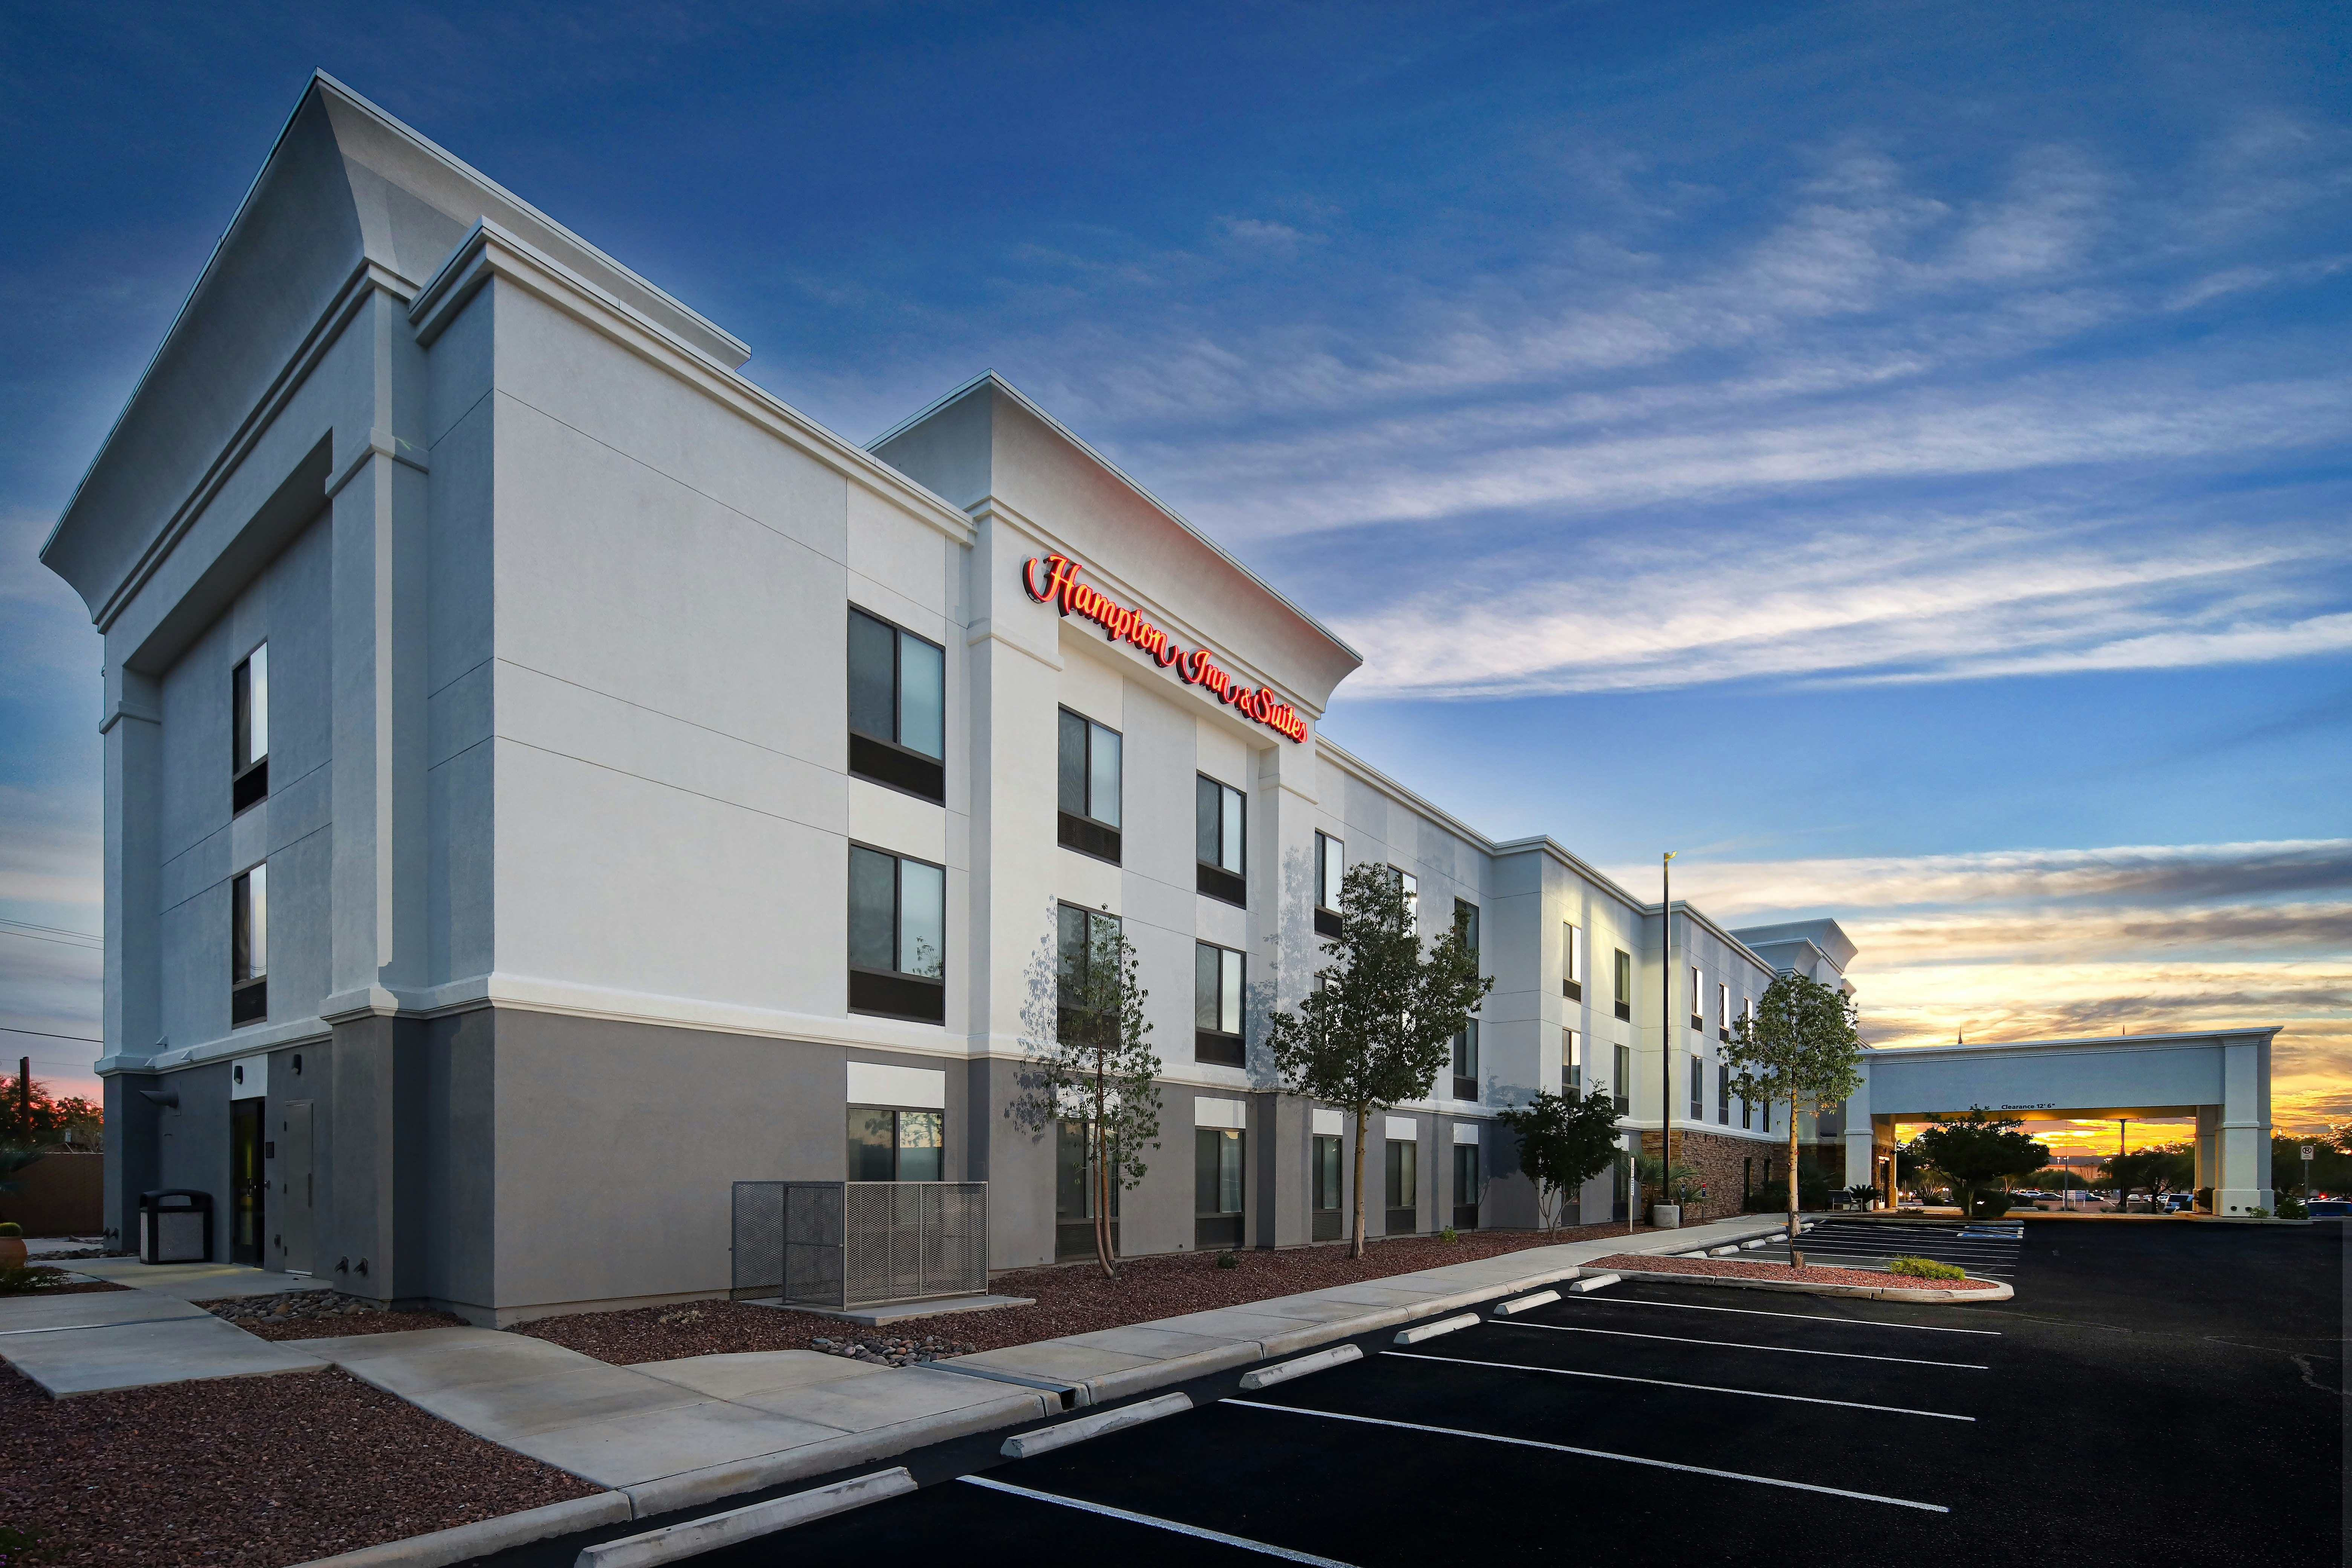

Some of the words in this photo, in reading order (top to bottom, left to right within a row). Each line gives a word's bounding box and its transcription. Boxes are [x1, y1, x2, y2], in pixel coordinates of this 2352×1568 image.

[1023, 555, 1179, 668] Hampton
[1177, 650, 1240, 704] Inn
[1237, 687, 1254, 718] &
[1253, 688, 1308, 743] Suites
